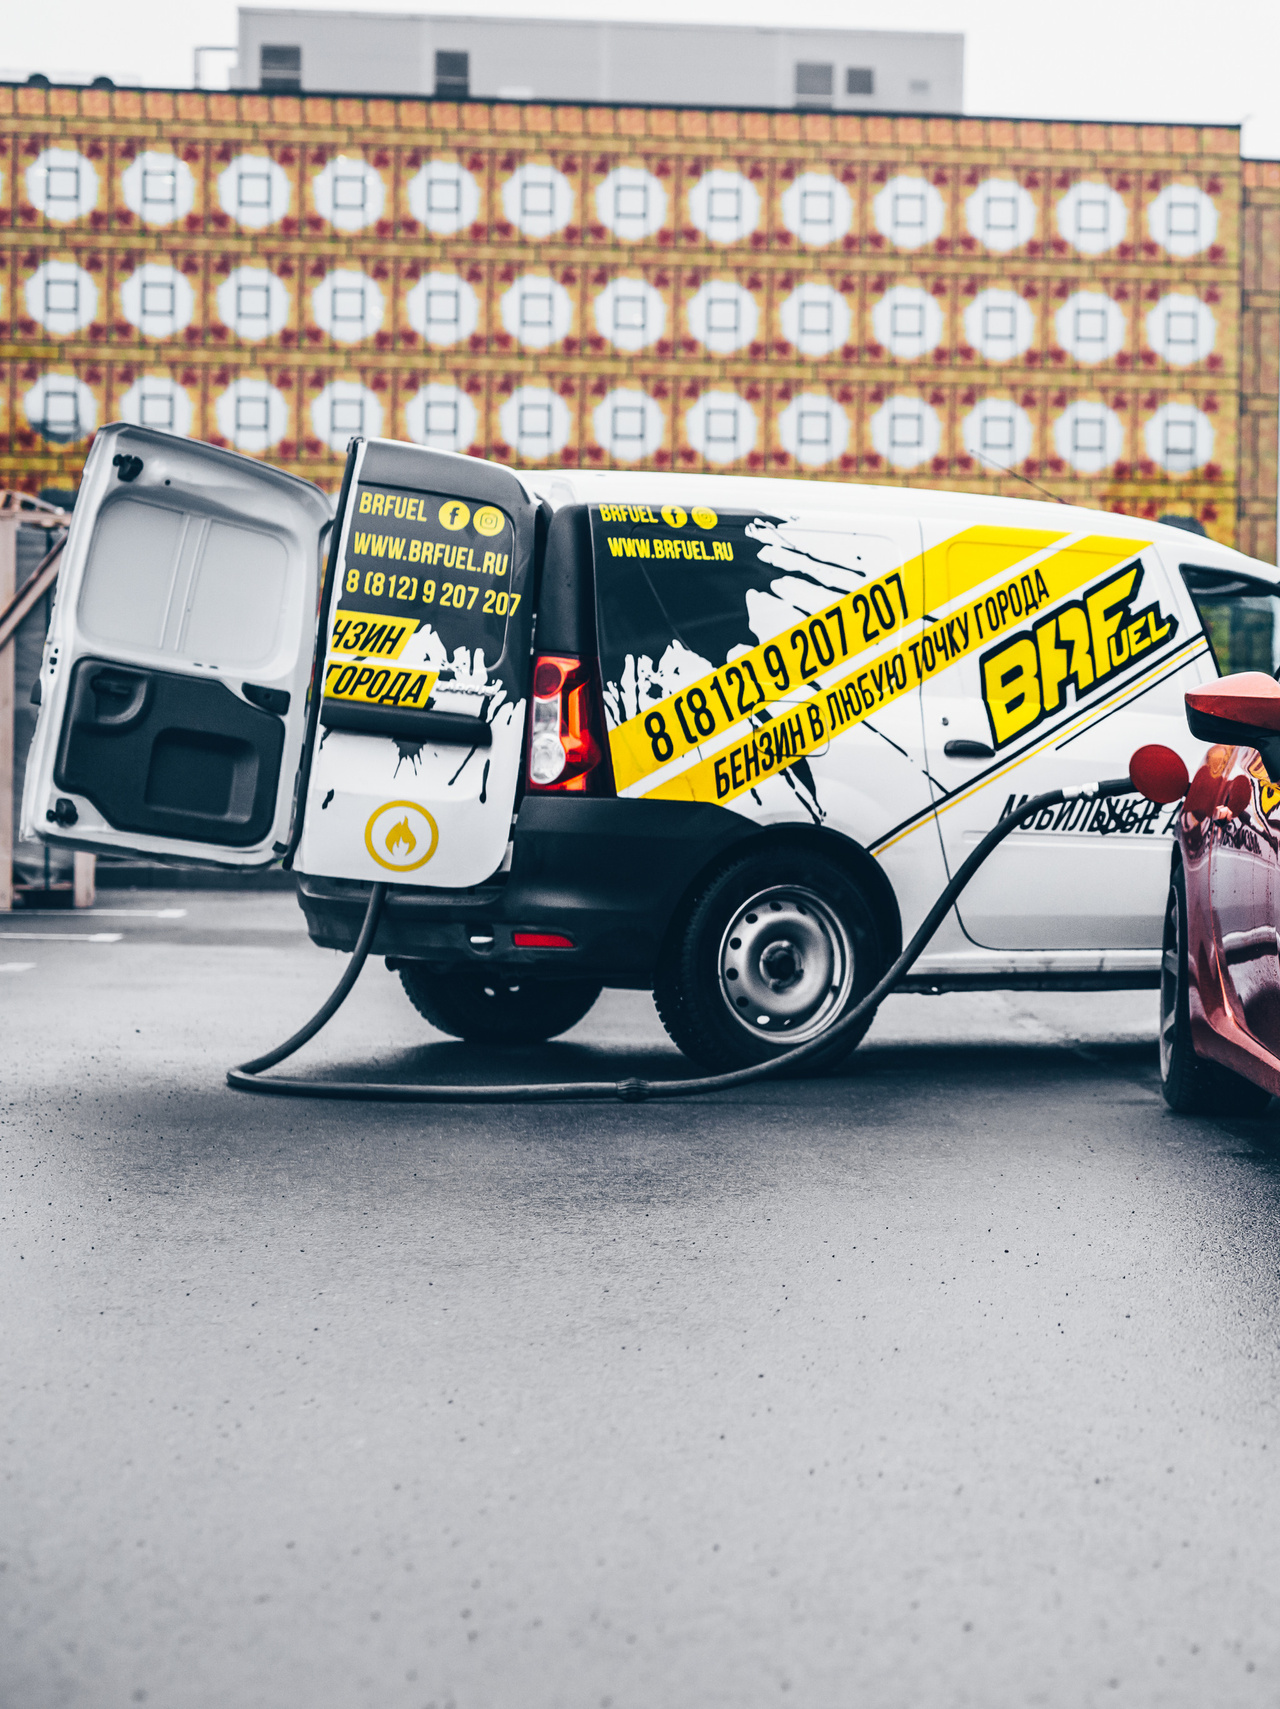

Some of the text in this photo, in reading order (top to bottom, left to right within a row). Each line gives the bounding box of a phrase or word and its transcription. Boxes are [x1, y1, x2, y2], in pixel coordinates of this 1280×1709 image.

[359, 492, 427, 522] BRFUEL
[599, 504, 658, 523] BRFUEL
[354, 532, 508, 576] WWW.BRFUEL.RU
[607, 537, 734, 561] WWW.BRFUEL.RU
[346, 569, 522, 617] 8 (812) 9 207 207
[326, 664, 427, 705] ГОРОДА
[644, 572, 909, 763] 8 (812) 9 207 207
[713, 568, 1050, 799] БЕНЗИН В ЛЮБУЮ ТОЧКУ ГОРОДА
